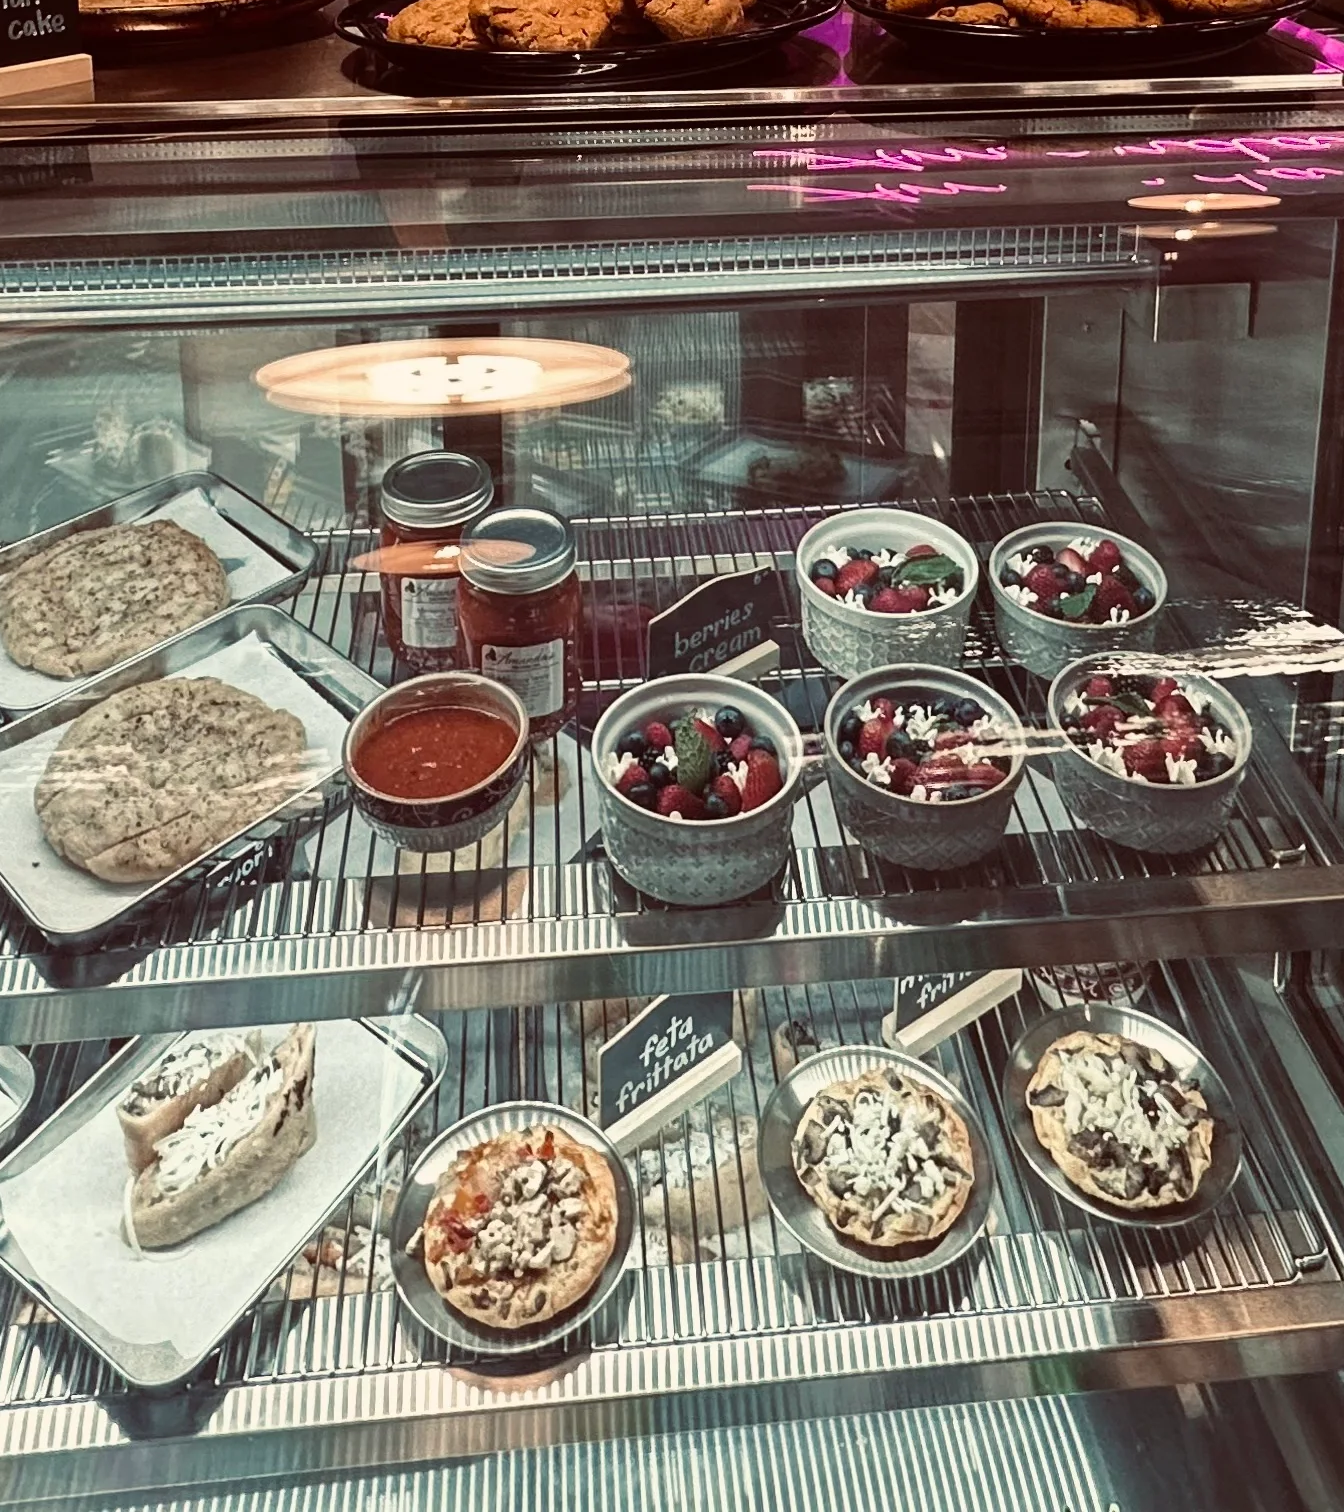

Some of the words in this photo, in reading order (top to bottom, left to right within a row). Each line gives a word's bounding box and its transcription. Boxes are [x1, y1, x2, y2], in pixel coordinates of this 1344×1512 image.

[8, 9, 66, 39] cake
[674, 602, 754, 658] berries
[688, 626, 762, 673] cream
[638, 1016, 693, 1067] feta
[615, 1033, 714, 1114] frittata
